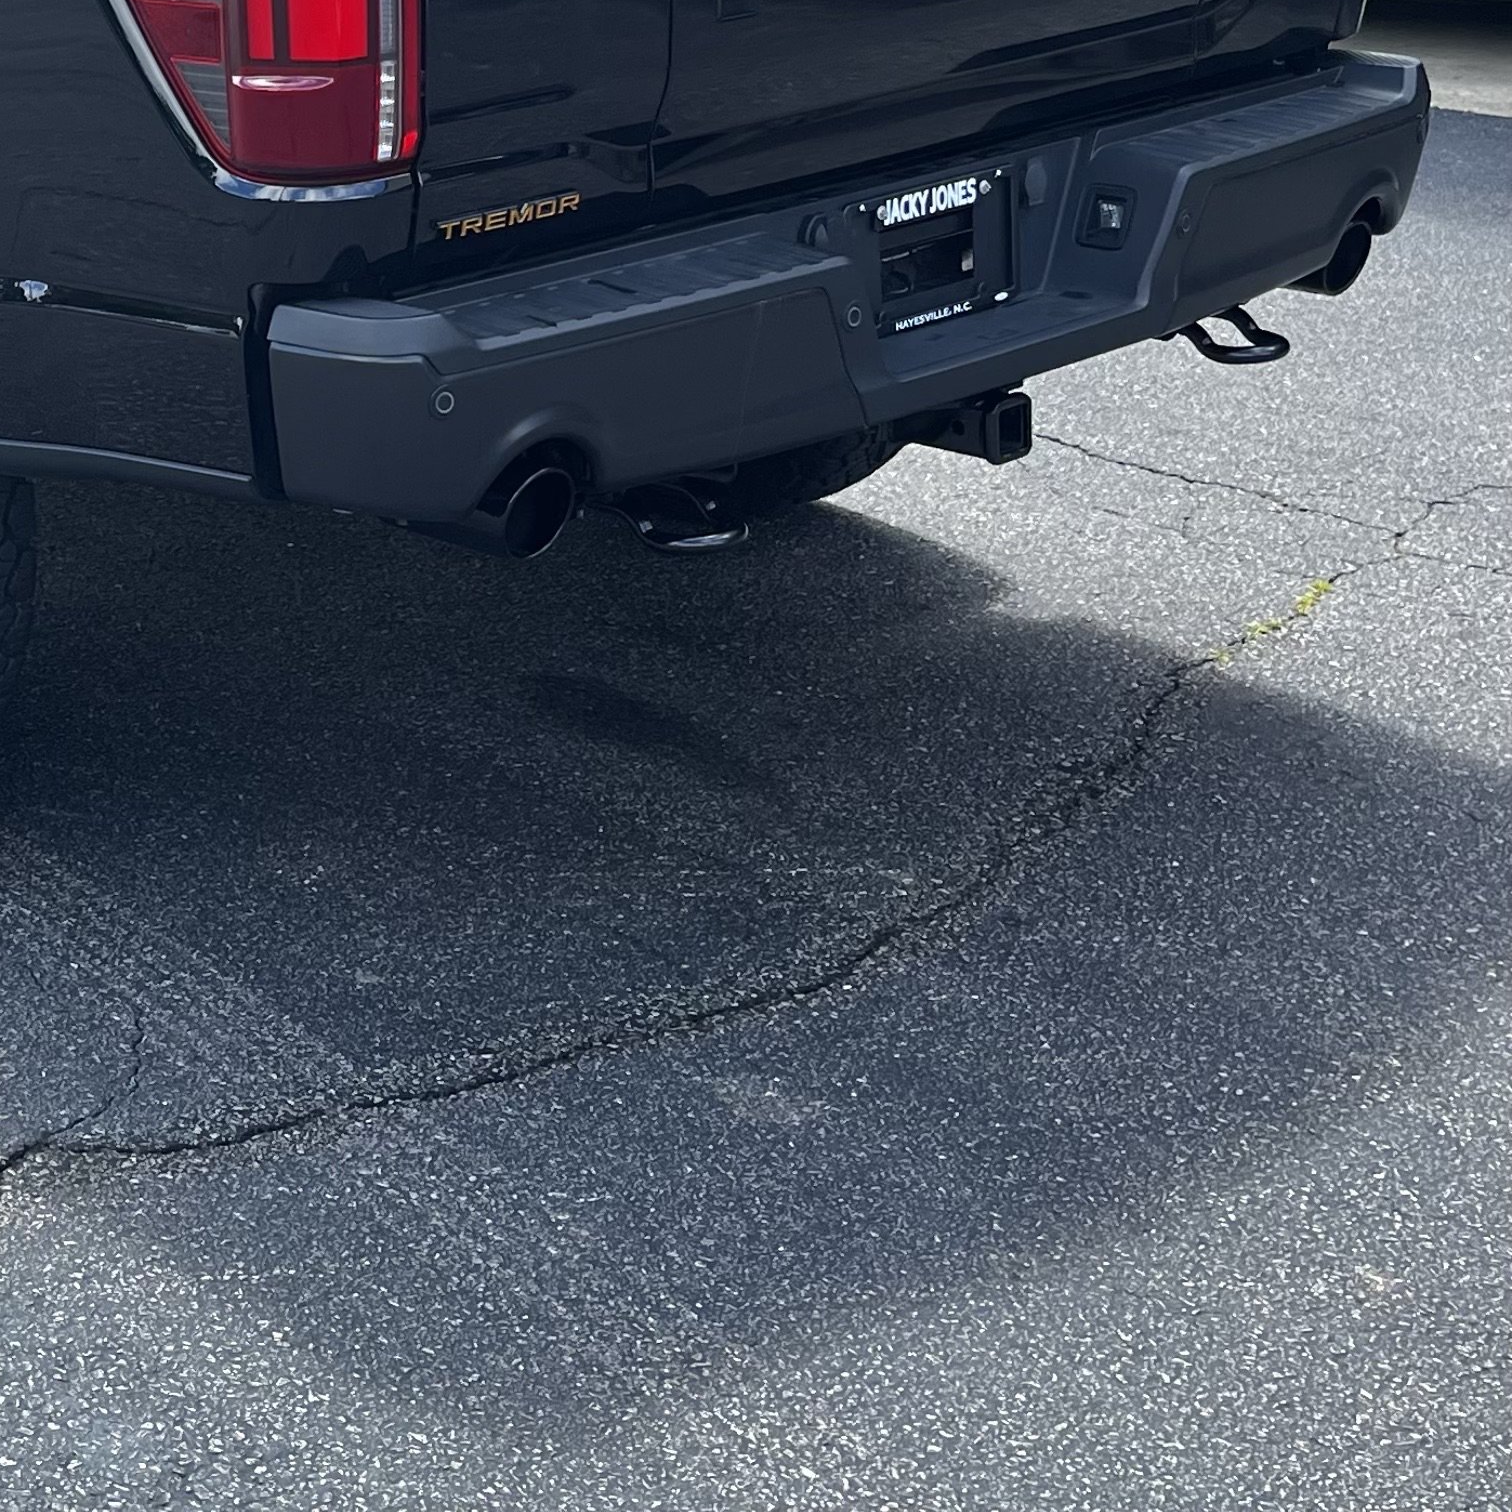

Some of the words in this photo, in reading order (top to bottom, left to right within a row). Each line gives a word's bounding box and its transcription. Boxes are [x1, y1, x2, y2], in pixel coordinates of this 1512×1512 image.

[437, 192, 581, 240] TREMOR
[883, 189, 929, 226] JACKY
[929, 177, 977, 214] JONES
